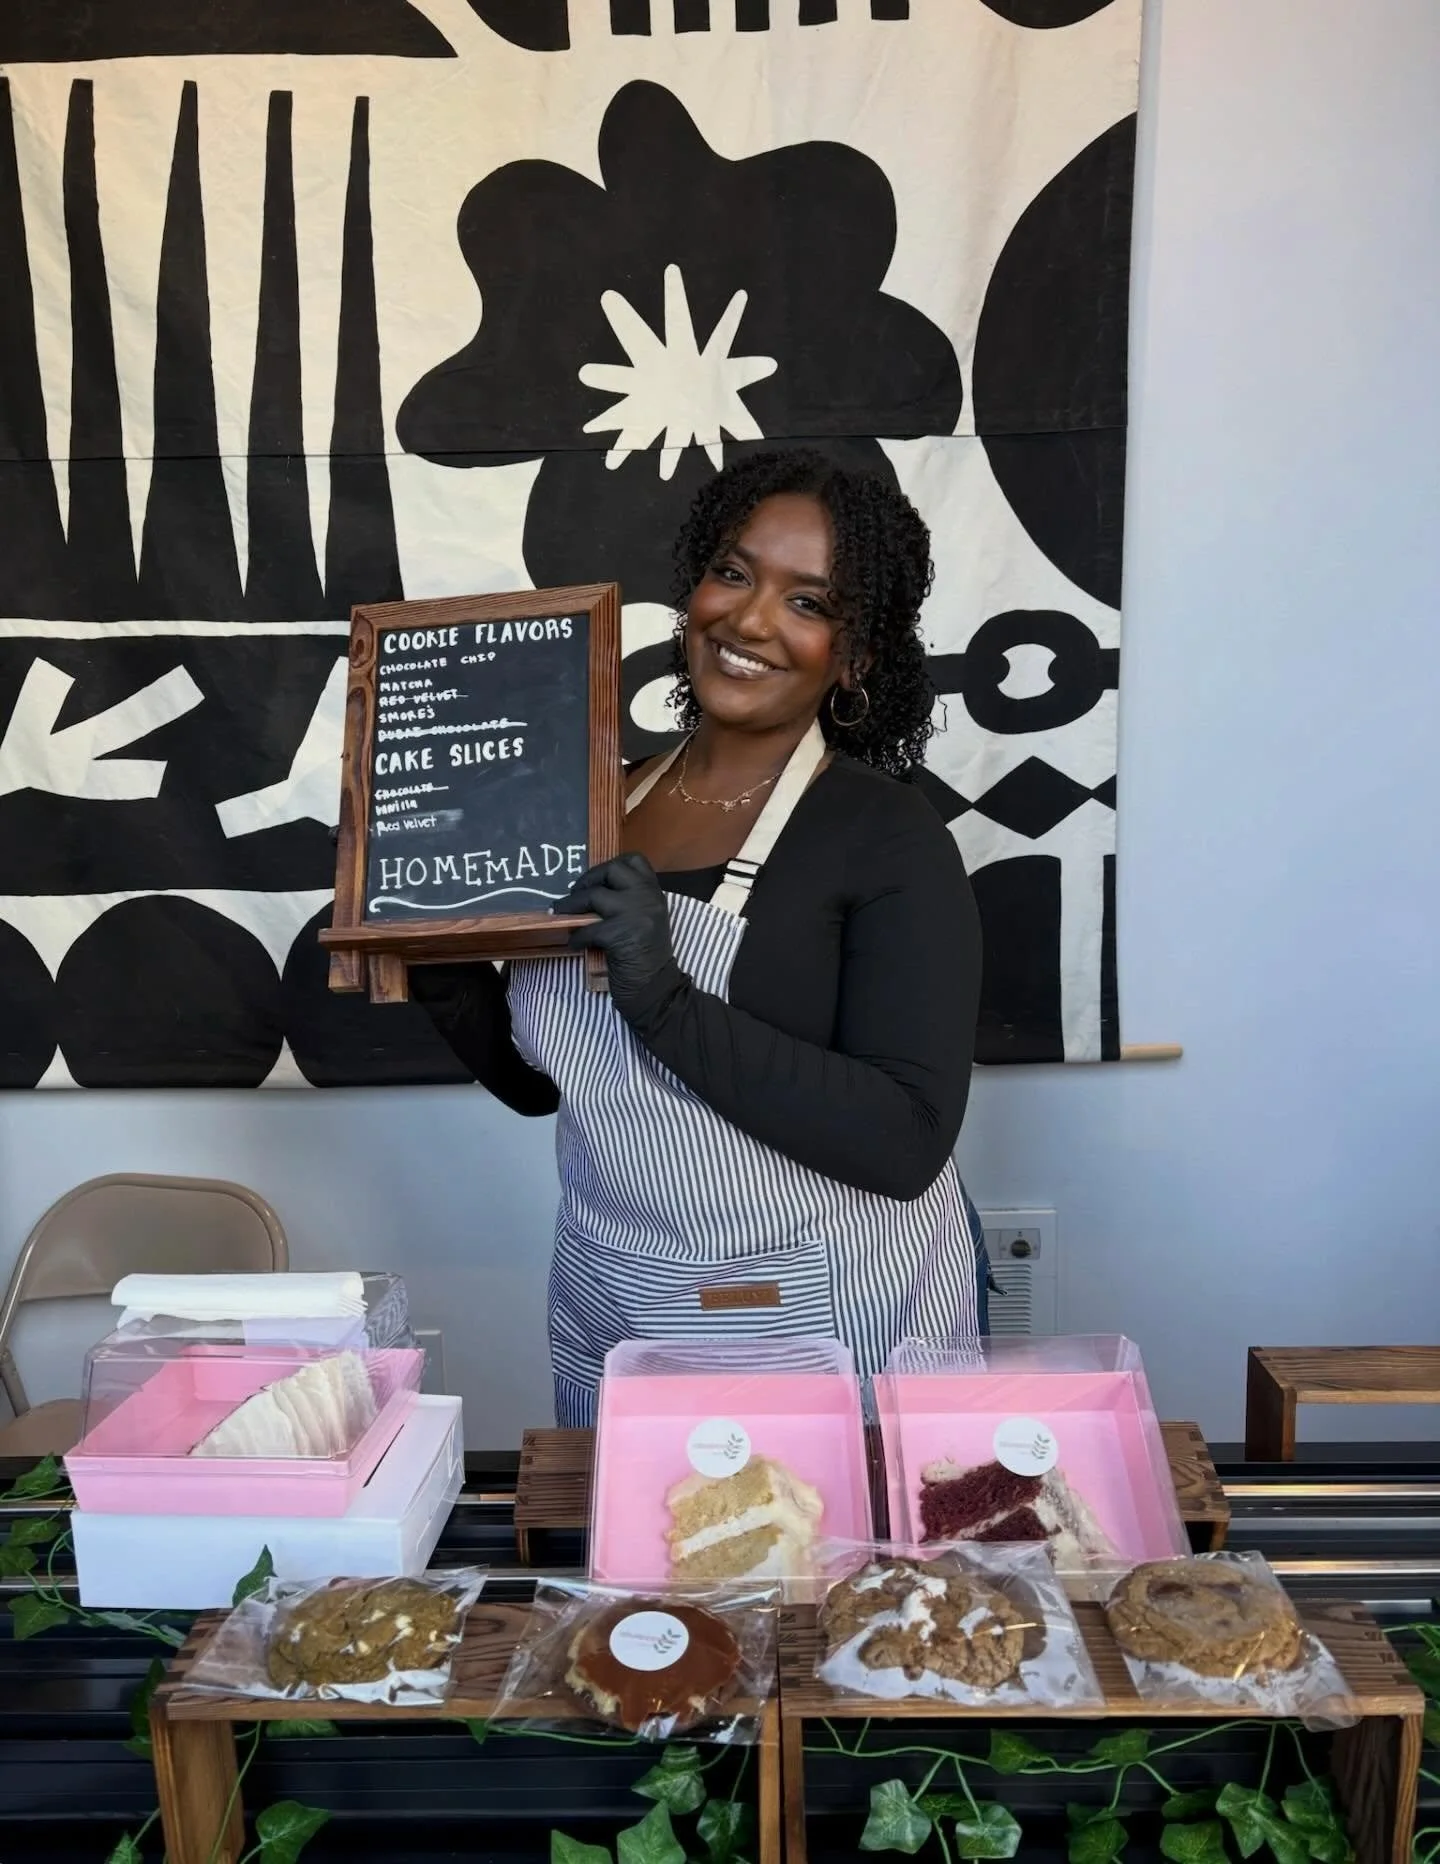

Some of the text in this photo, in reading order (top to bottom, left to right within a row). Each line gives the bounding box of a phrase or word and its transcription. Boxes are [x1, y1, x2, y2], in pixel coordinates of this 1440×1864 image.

[384, 617, 573, 654] COOKIE FLAVORS
[379, 652, 496, 675] CHOCOLATE CHIP
[380, 679, 433, 692] MATCHA
[375, 737, 524, 775] CAKE SLICES
[380, 843, 586, 890] HOMEMADE
